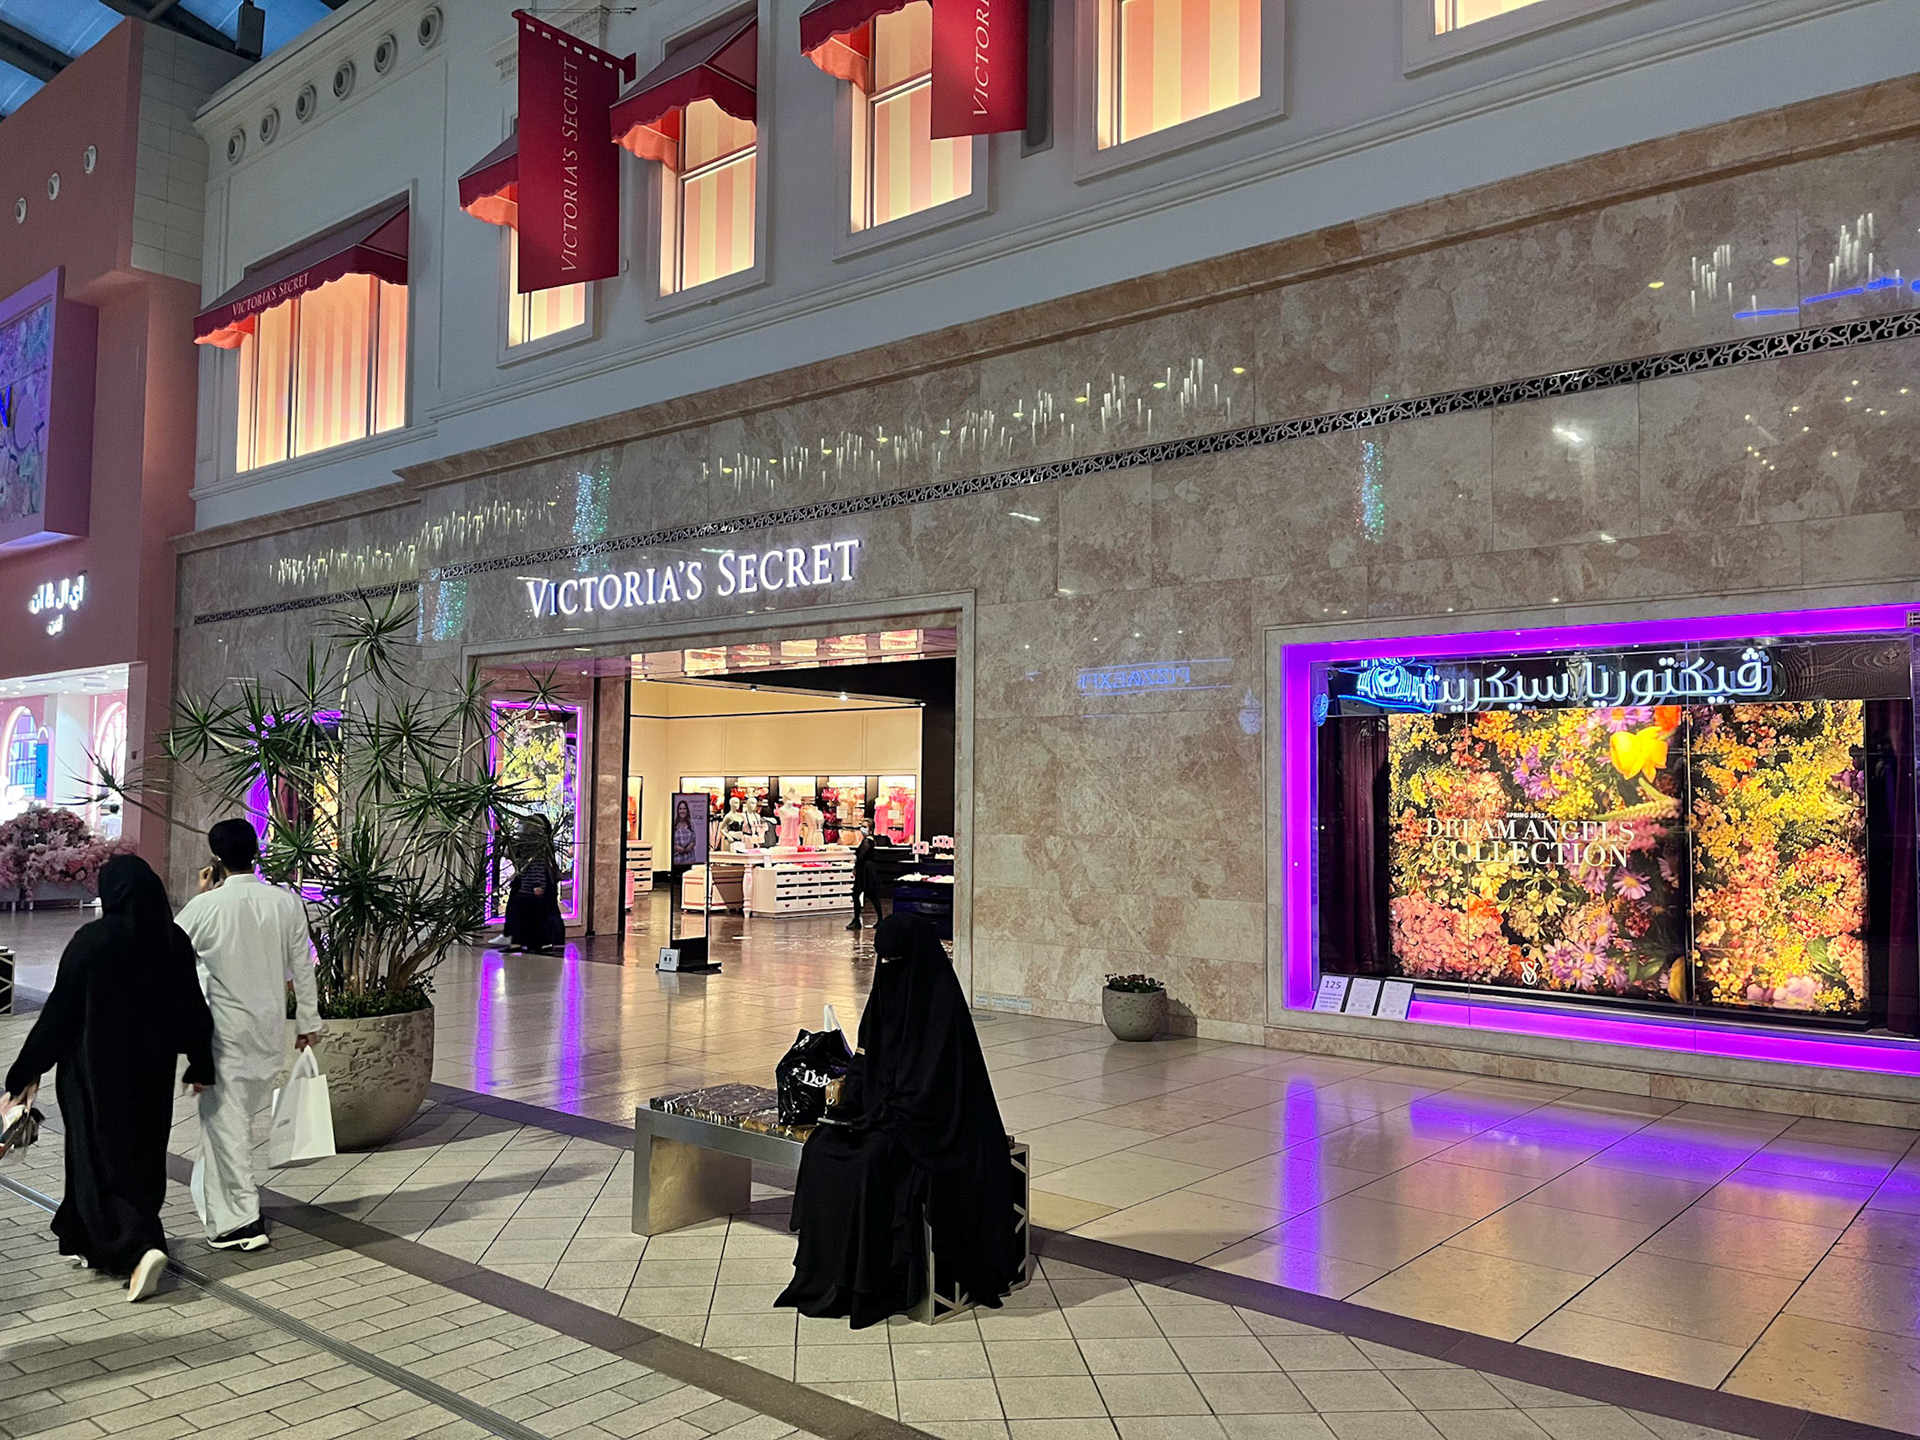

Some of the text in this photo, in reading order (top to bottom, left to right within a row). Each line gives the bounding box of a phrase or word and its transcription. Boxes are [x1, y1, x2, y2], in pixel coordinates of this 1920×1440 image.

[561, 57, 579, 272] VICTORIA'S SECRET
[232, 272, 309, 316] VICTORIA'S SECRET
[526, 539, 860, 619] VICTORIA'S SECRET
[1420, 666, 1570, 712] سيكريت
[1426, 817, 1636, 843] DREAM ANGELS
[1432, 839, 1630, 868] COLLECTION
[1324, 980, 1342, 990] 125
